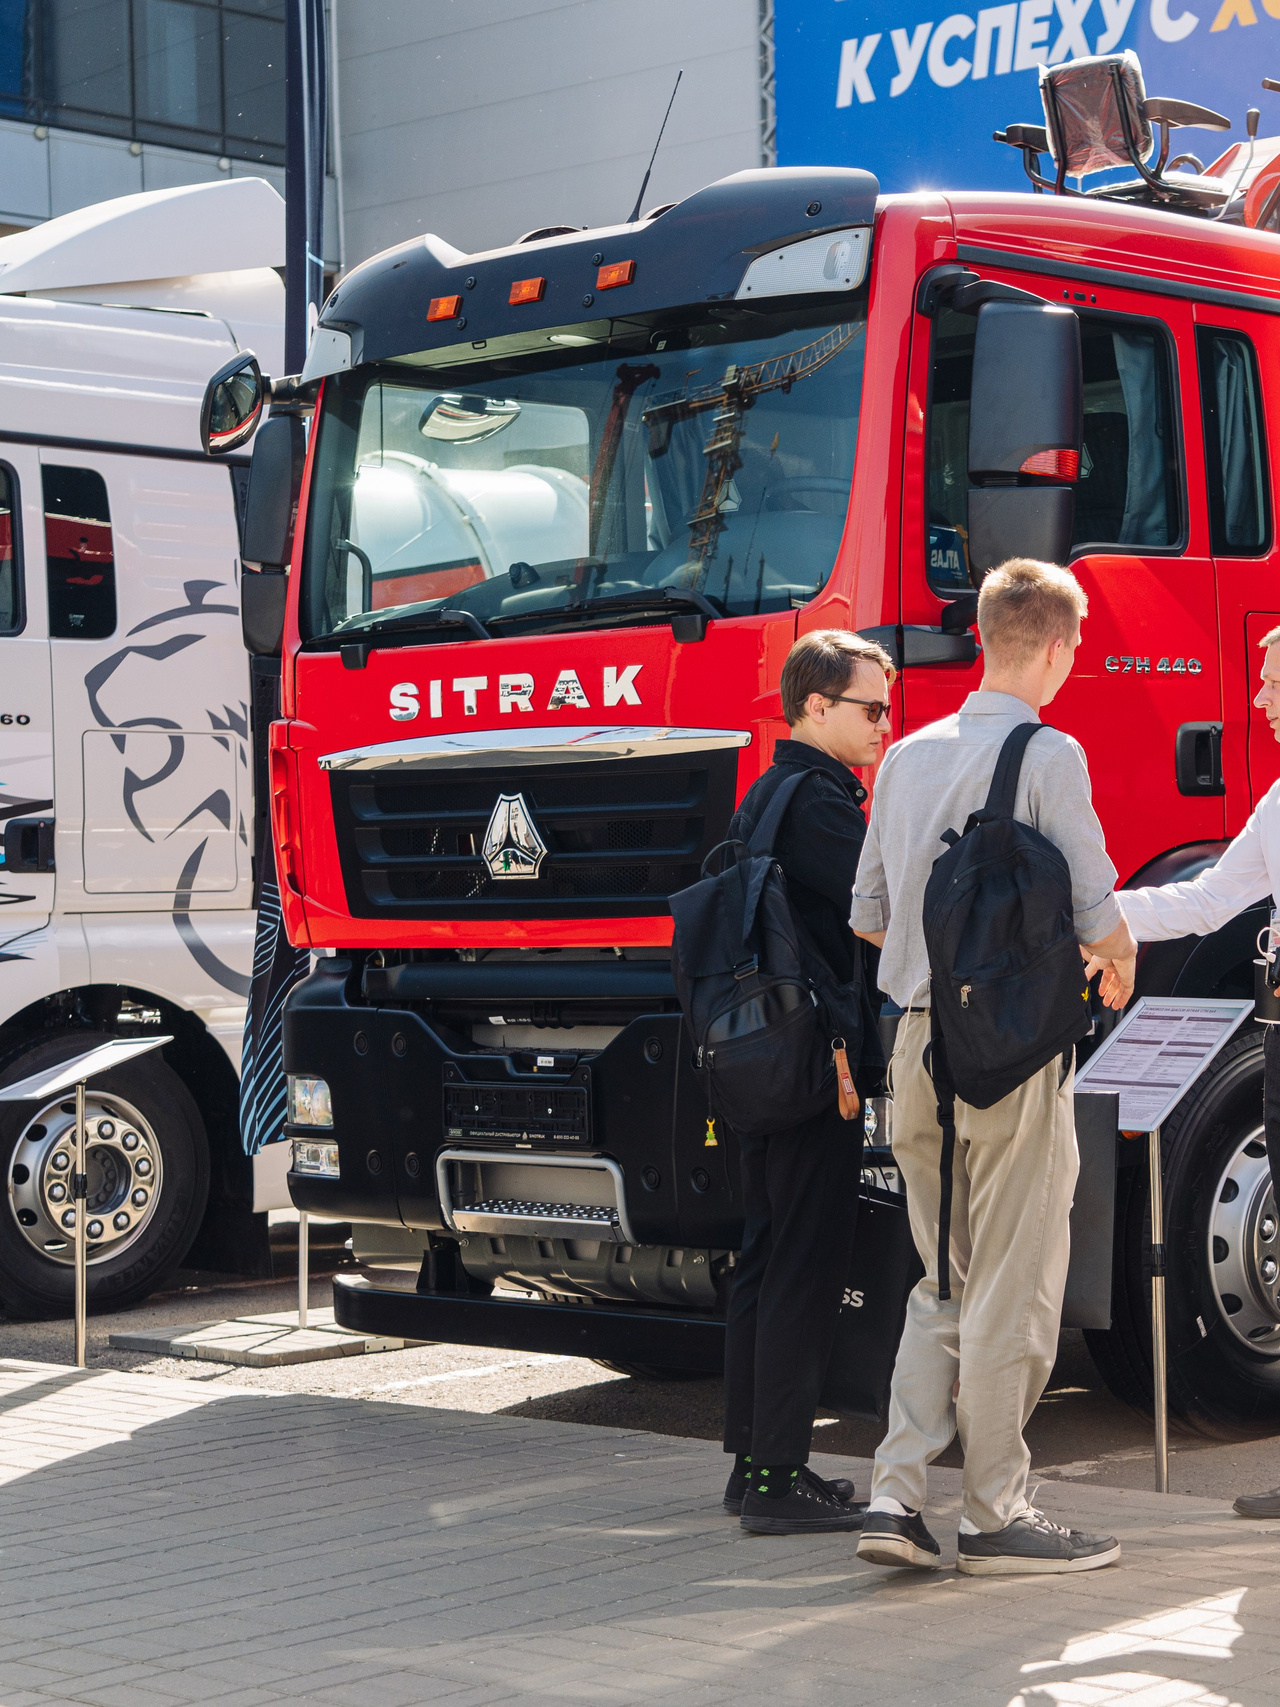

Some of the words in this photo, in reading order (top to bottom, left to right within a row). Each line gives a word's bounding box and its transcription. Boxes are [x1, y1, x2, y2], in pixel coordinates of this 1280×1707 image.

[835, 33, 883, 109] К
[890, 0, 1136, 98] УСПЕХУ
[1105, 655, 1151, 674] C7H
[1156, 657, 1202, 675] 440
[389, 664, 644, 722] SITRAK
[0, 713, 31, 726] 60
